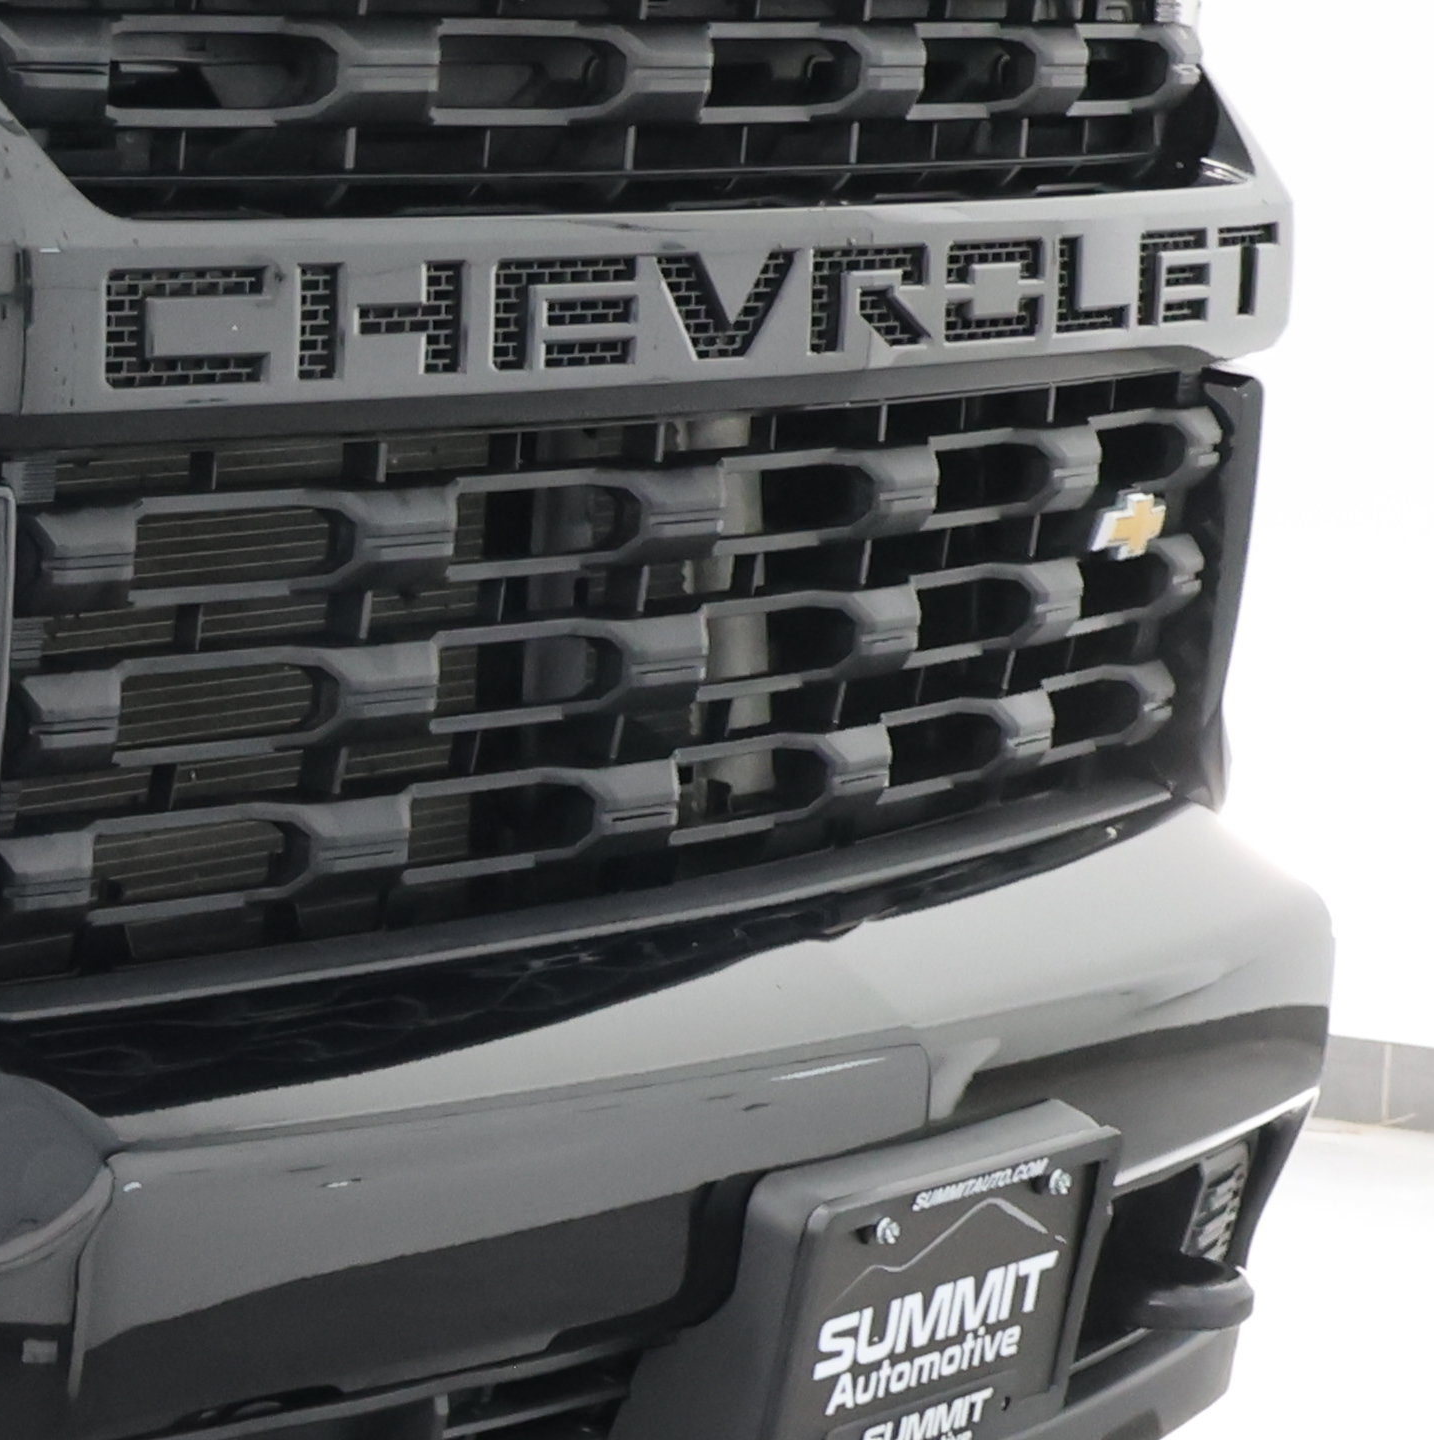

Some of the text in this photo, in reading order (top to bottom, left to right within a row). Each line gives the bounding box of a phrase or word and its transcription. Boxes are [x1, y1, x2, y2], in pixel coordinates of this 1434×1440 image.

[104, 222, 1277, 389] CHEVROLET
[812, 1250, 1059, 1380] SUMMIT
[825, 1325, 1022, 1416] Automotive
